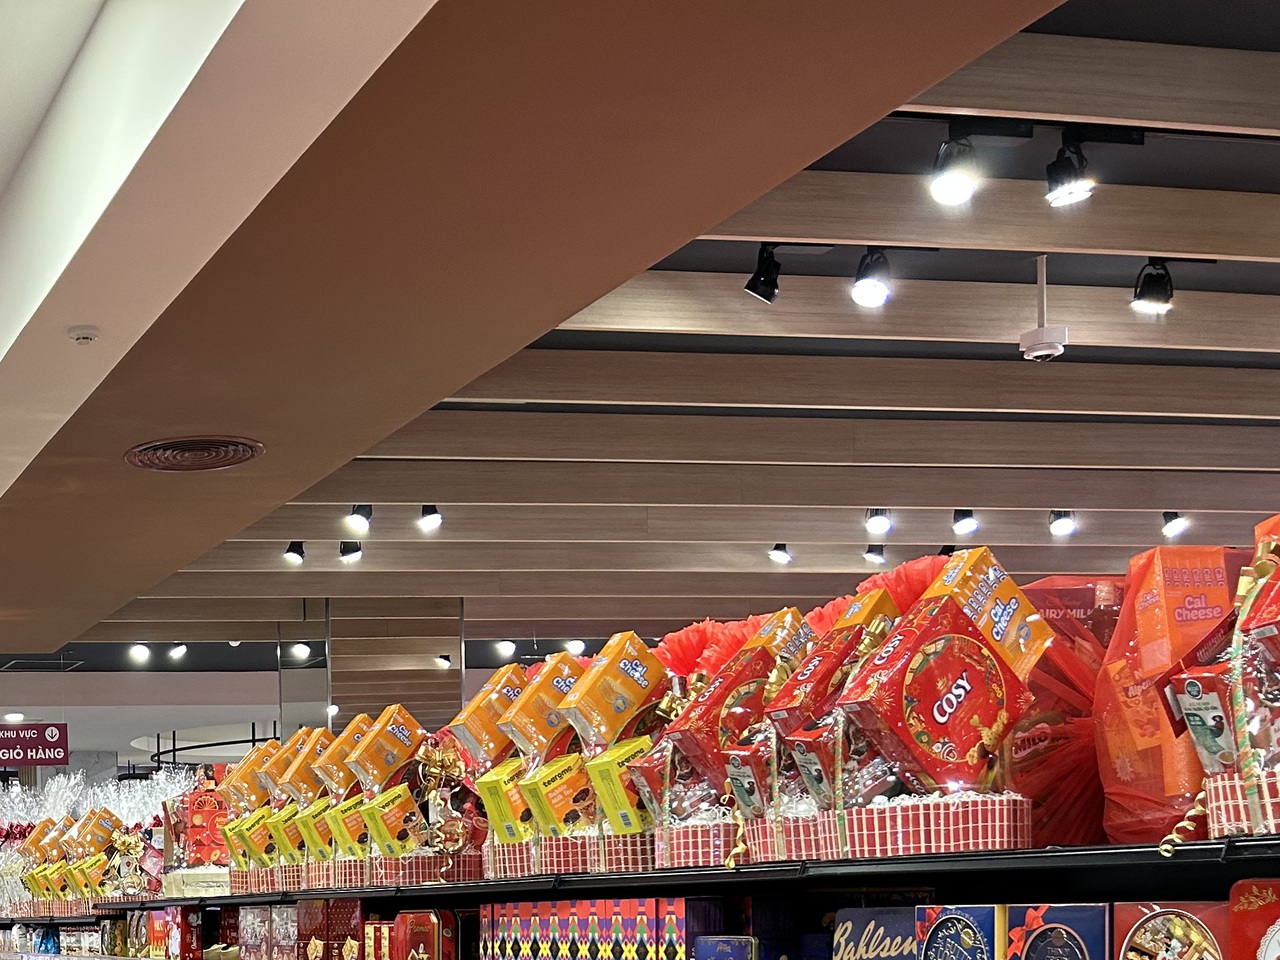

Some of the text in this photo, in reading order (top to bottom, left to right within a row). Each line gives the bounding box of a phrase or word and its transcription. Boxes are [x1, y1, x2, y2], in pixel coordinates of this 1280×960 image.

[989, 597, 1004, 623] Cal
[1184, 594, 1207, 609] Cal
[991, 597, 1020, 643] Cheese
[1038, 609, 1063, 620] AIRY
[1174, 605, 1222, 623] Cheese
[874, 635, 905, 666] COSY
[631, 659, 647, 674] Cal
[797, 655, 823, 681] COSY
[933, 670, 973, 724] COSY
[19, 729, 38, 740] VỰC
[0, 745, 64, 760] GIỎ HÀNG
[542, 766, 574, 789] tearoma
